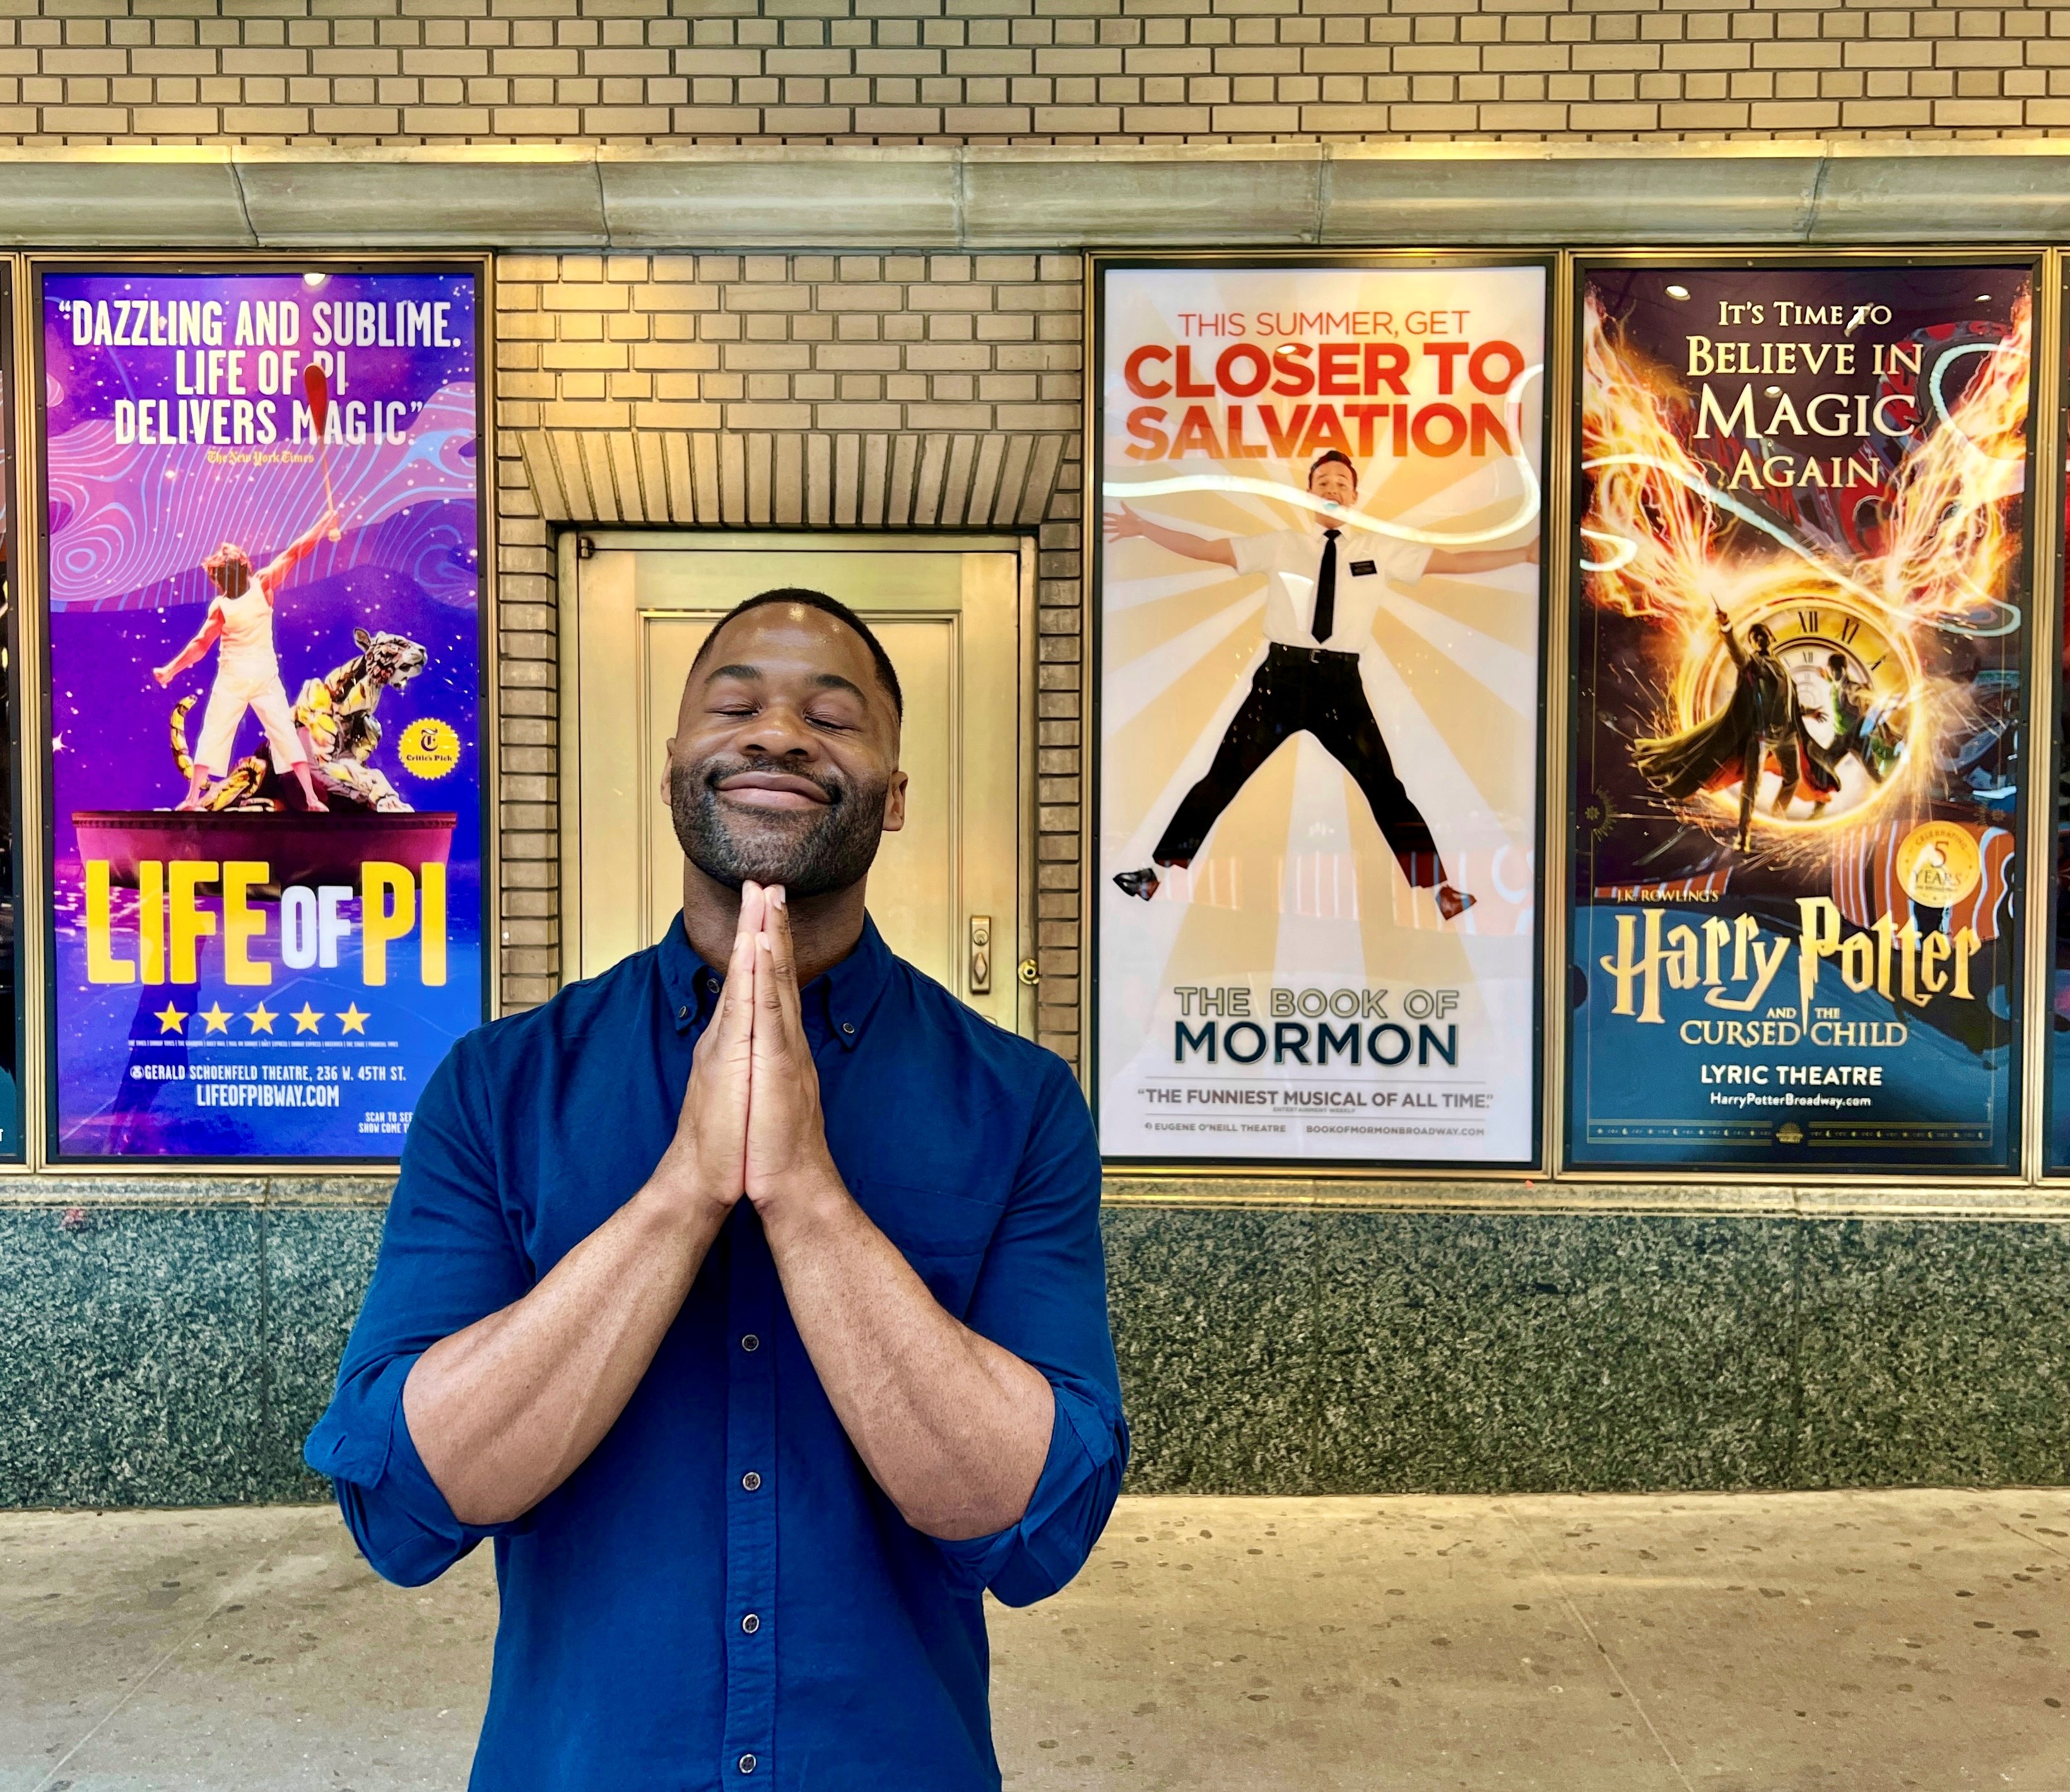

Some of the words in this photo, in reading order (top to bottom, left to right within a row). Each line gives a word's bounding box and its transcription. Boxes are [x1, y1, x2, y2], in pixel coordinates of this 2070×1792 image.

[59, 300, 222, 346] “DAZZLING
[235, 300, 299, 346] AND
[312, 301, 461, 347] SUBLIME.
[1177, 313, 1246, 336] THIS
[1256, 311, 1399, 338] SUMMER,
[1405, 310, 1470, 335] GET
[1719, 301, 1764, 326] IT'S
[1773, 301, 1843, 326] TIME
[1124, 342, 1411, 399] CLOSER
[1423, 340, 1525, 395] TO
[1686, 335, 1855, 376] BELIEVE
[1872, 343, 1924, 375] IN
[176, 350, 246, 396] LIFE
[258, 350, 300, 396] OF
[115, 399, 277, 445] DELIVERS
[1693, 382, 1915, 439] MAGIC
[1124, 403, 1522, 461] SALVATION
[208, 451, 226, 464] The
[229, 450, 251, 466] New
[254, 450, 280, 467] York
[282, 450, 314, 464] Times
[1727, 449, 1881, 490] AGAIN
[1931, 840, 1949, 868] 5
[1912, 869, 1963, 887] YEARS
[1617, 889, 1638, 903] J.K.
[1642, 889, 1719, 903] ROWLING'S
[86, 859, 273, 986] LIFE
[280, 885, 354, 969] OF
[361, 861, 447, 986] PI
[1600, 908, 1791, 1023] Harry
[1795, 896, 1982, 1035] Potter
[1174, 987, 1250, 1017] THE
[1270, 988, 1388, 1018] BOOK
[1404, 989, 1459, 1018] OF
[1766, 1008, 1796, 1019] AND
[1814, 1007, 1840, 1019] THE
[1175, 1021, 1459, 1066] MORMON
[1679, 1020, 1801, 1048] CURSED
[1811, 1022, 1908, 1047] CHILD
[144, 1064, 185, 1080] GERALD
[190, 1065, 258, 1080] SCHOENFELD
[262, 1065, 313, 1082] THEATRE,
[317, 1066, 338, 1081] 236
[342, 1066, 354, 1081] W.
[358, 1066, 386, 1082] 45TH
[390, 1066, 406, 1082] ST.
[1700, 1064, 1769, 1085] LYRIC
[1775, 1066, 1883, 1085] THEATRE
[196, 1084, 340, 1107] LIFEOFPIBWAY.COM
[1138, 1089, 1182, 1103] “THE
[1187, 1090, 1278, 1104] FUNNIEST
[1284, 1091, 1367, 1105] MUSICAL
[1372, 1092, 1397, 1106] OF
[1402, 1093, 1437, 1107] ALL
[1710, 1092, 1872, 1109] HarryPotterBroadway.com
[358, 1123, 379, 1134] SHOW
[381, 1123, 401, 1134] COME
[365, 1112, 385, 1123] SCAN
[387, 1112, 397, 1123] TO
[1199, 1123, 1238, 1131] O'NEILL
[1306, 1125, 1485, 1136] BOOKOFMORMONBROADWAY.COM
